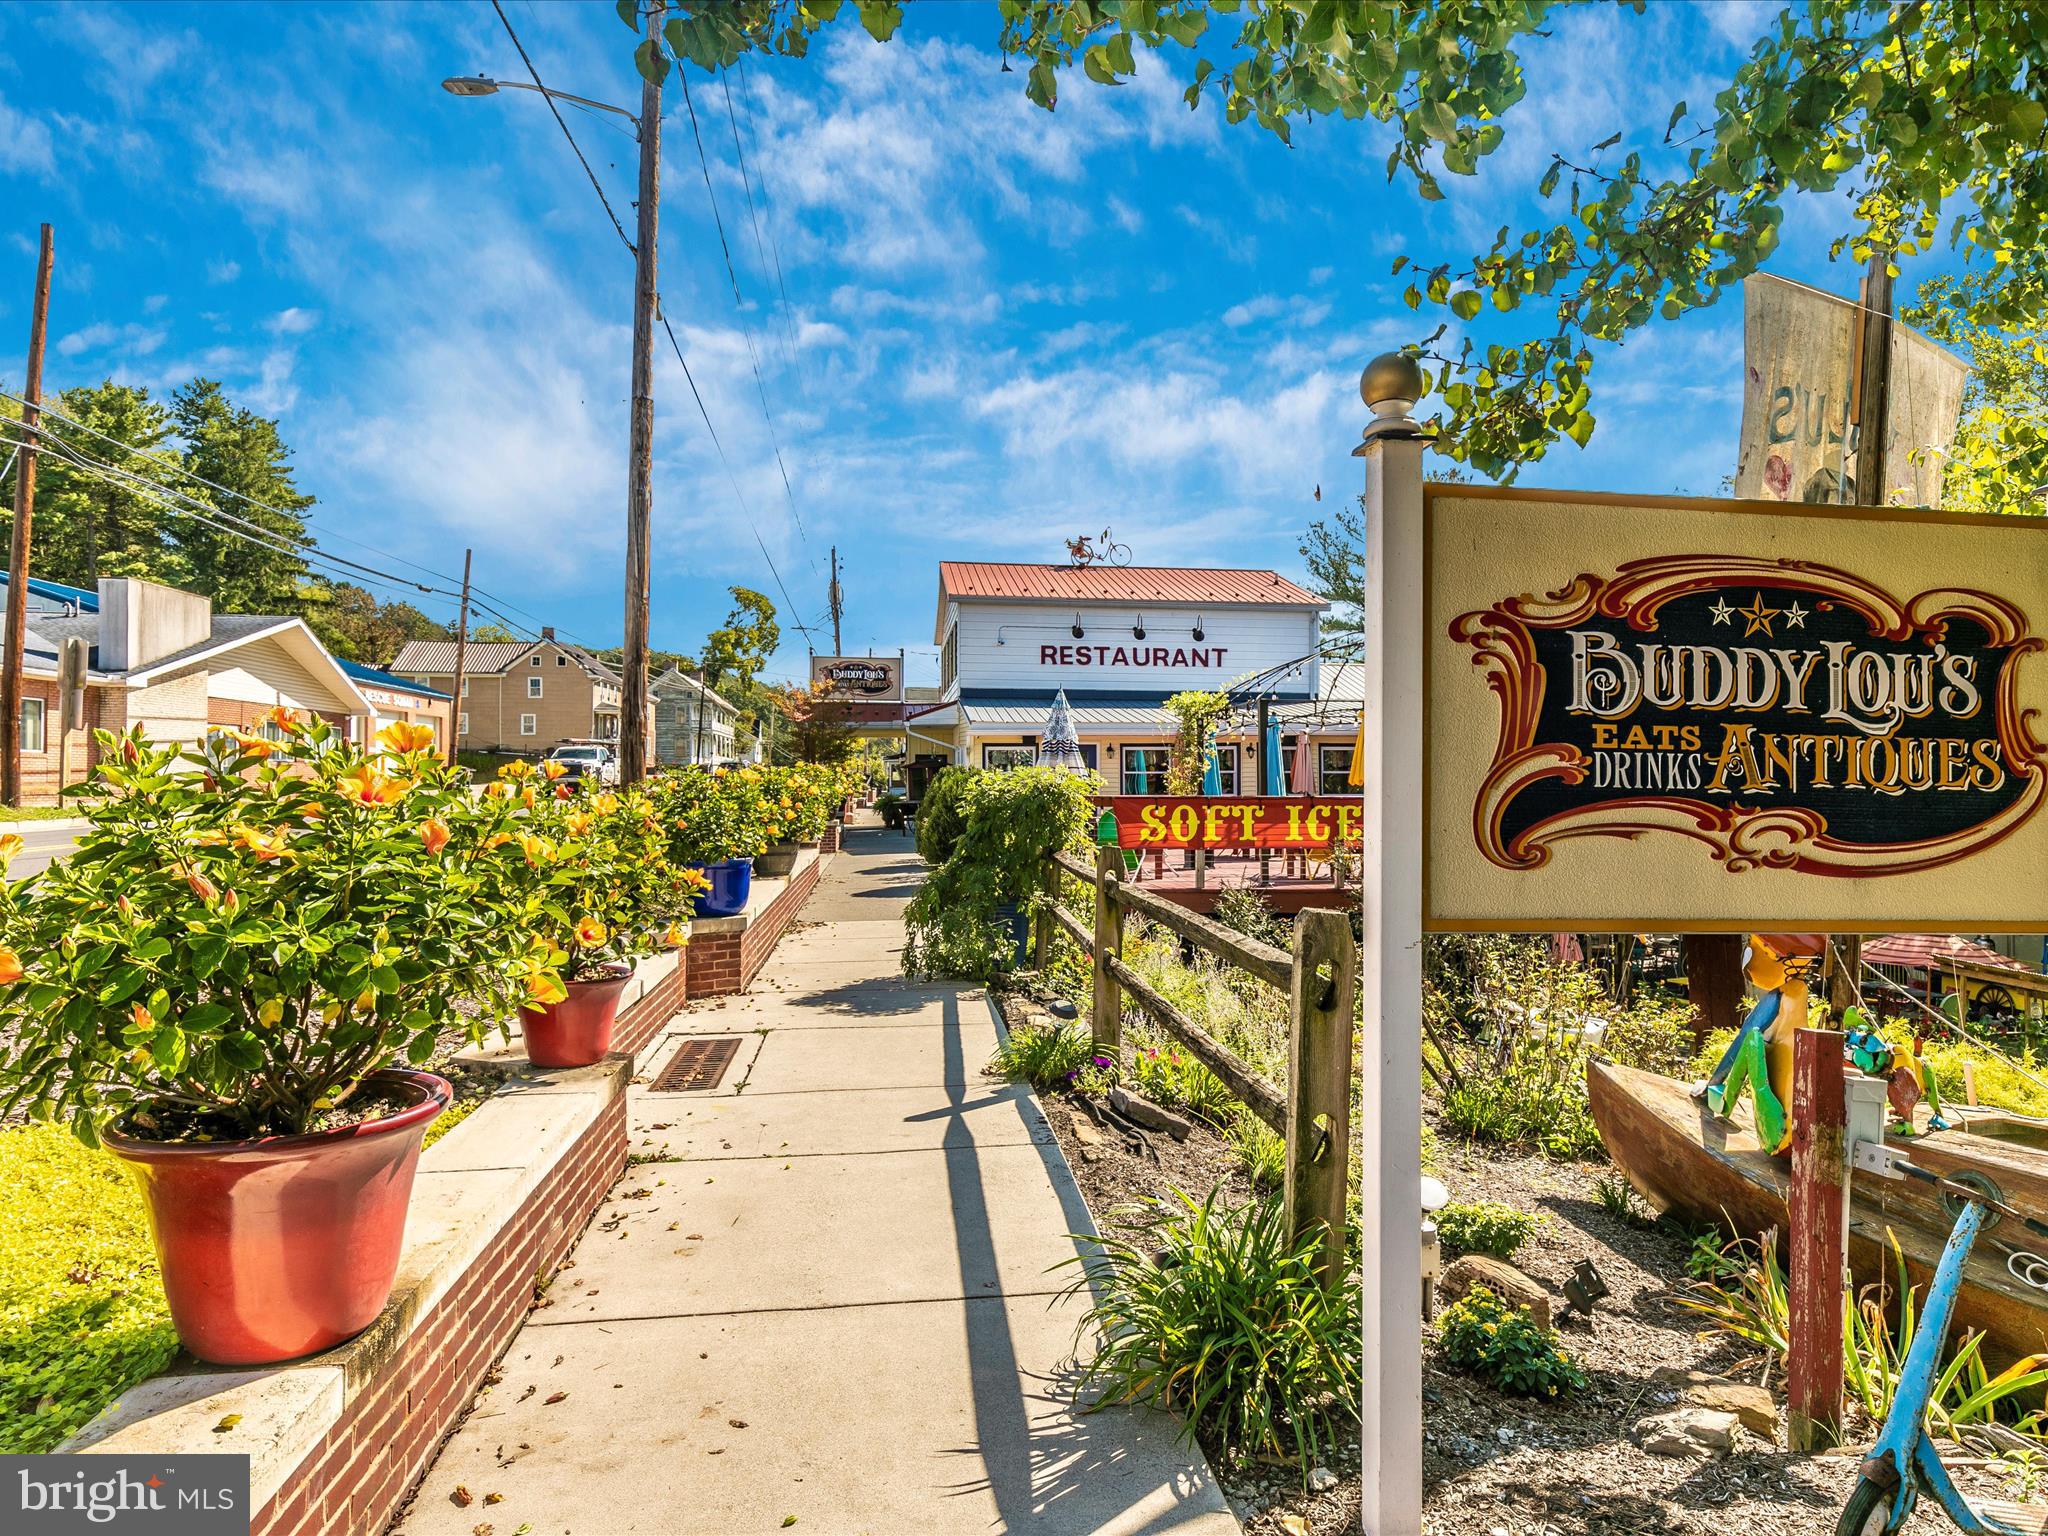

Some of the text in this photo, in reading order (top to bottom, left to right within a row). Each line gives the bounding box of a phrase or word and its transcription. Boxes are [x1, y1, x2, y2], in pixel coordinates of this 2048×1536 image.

[1040, 645, 1228, 668] RESTAURANT
[1566, 630, 1981, 735] BUDDY LOU'S
[1592, 724, 1701, 750] EATS
[1593, 751, 1701, 791] DRINKS
[1704, 723, 2006, 795] ANTIQUES
[1139, 804, 1363, 842] SOFT ICE
